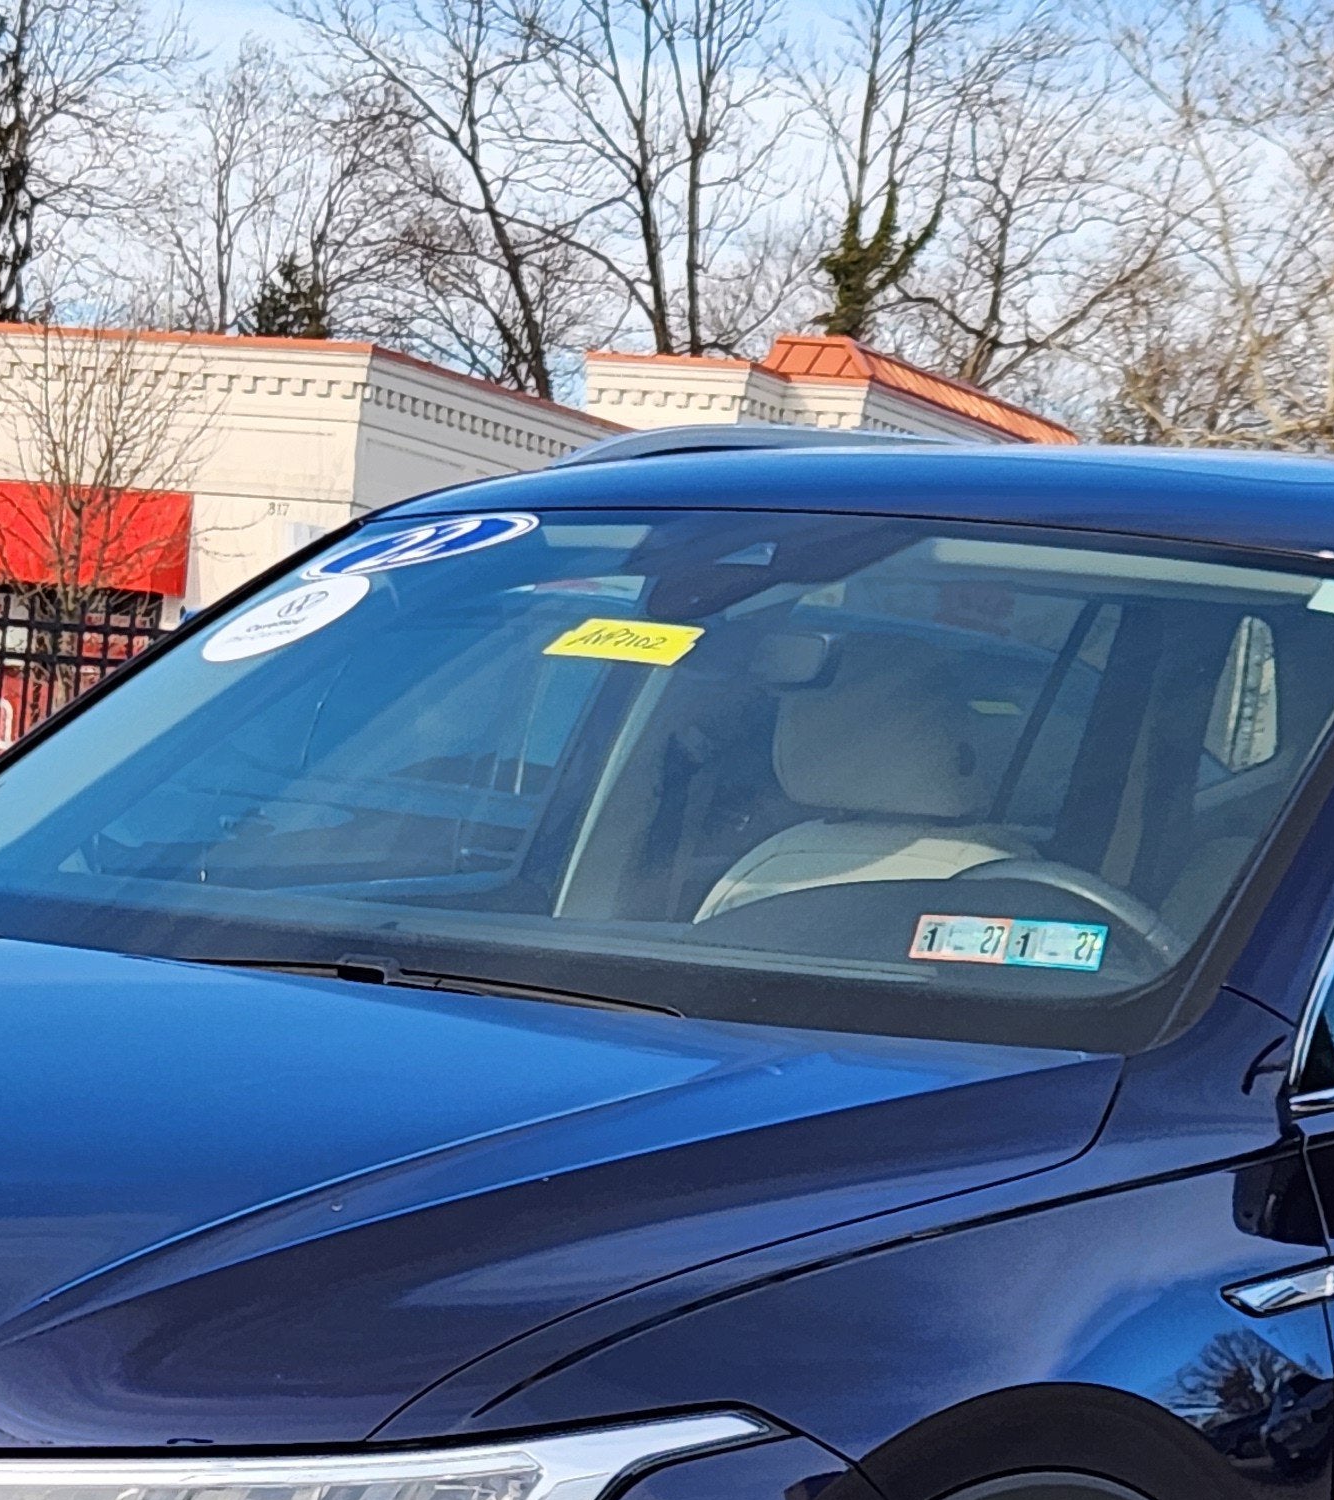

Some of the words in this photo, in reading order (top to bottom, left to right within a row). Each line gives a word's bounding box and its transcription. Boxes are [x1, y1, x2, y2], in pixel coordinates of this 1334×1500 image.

[341, 519, 482, 574] 22
[979, 925, 1005, 956] 27
[1074, 931, 1099, 962] 27
